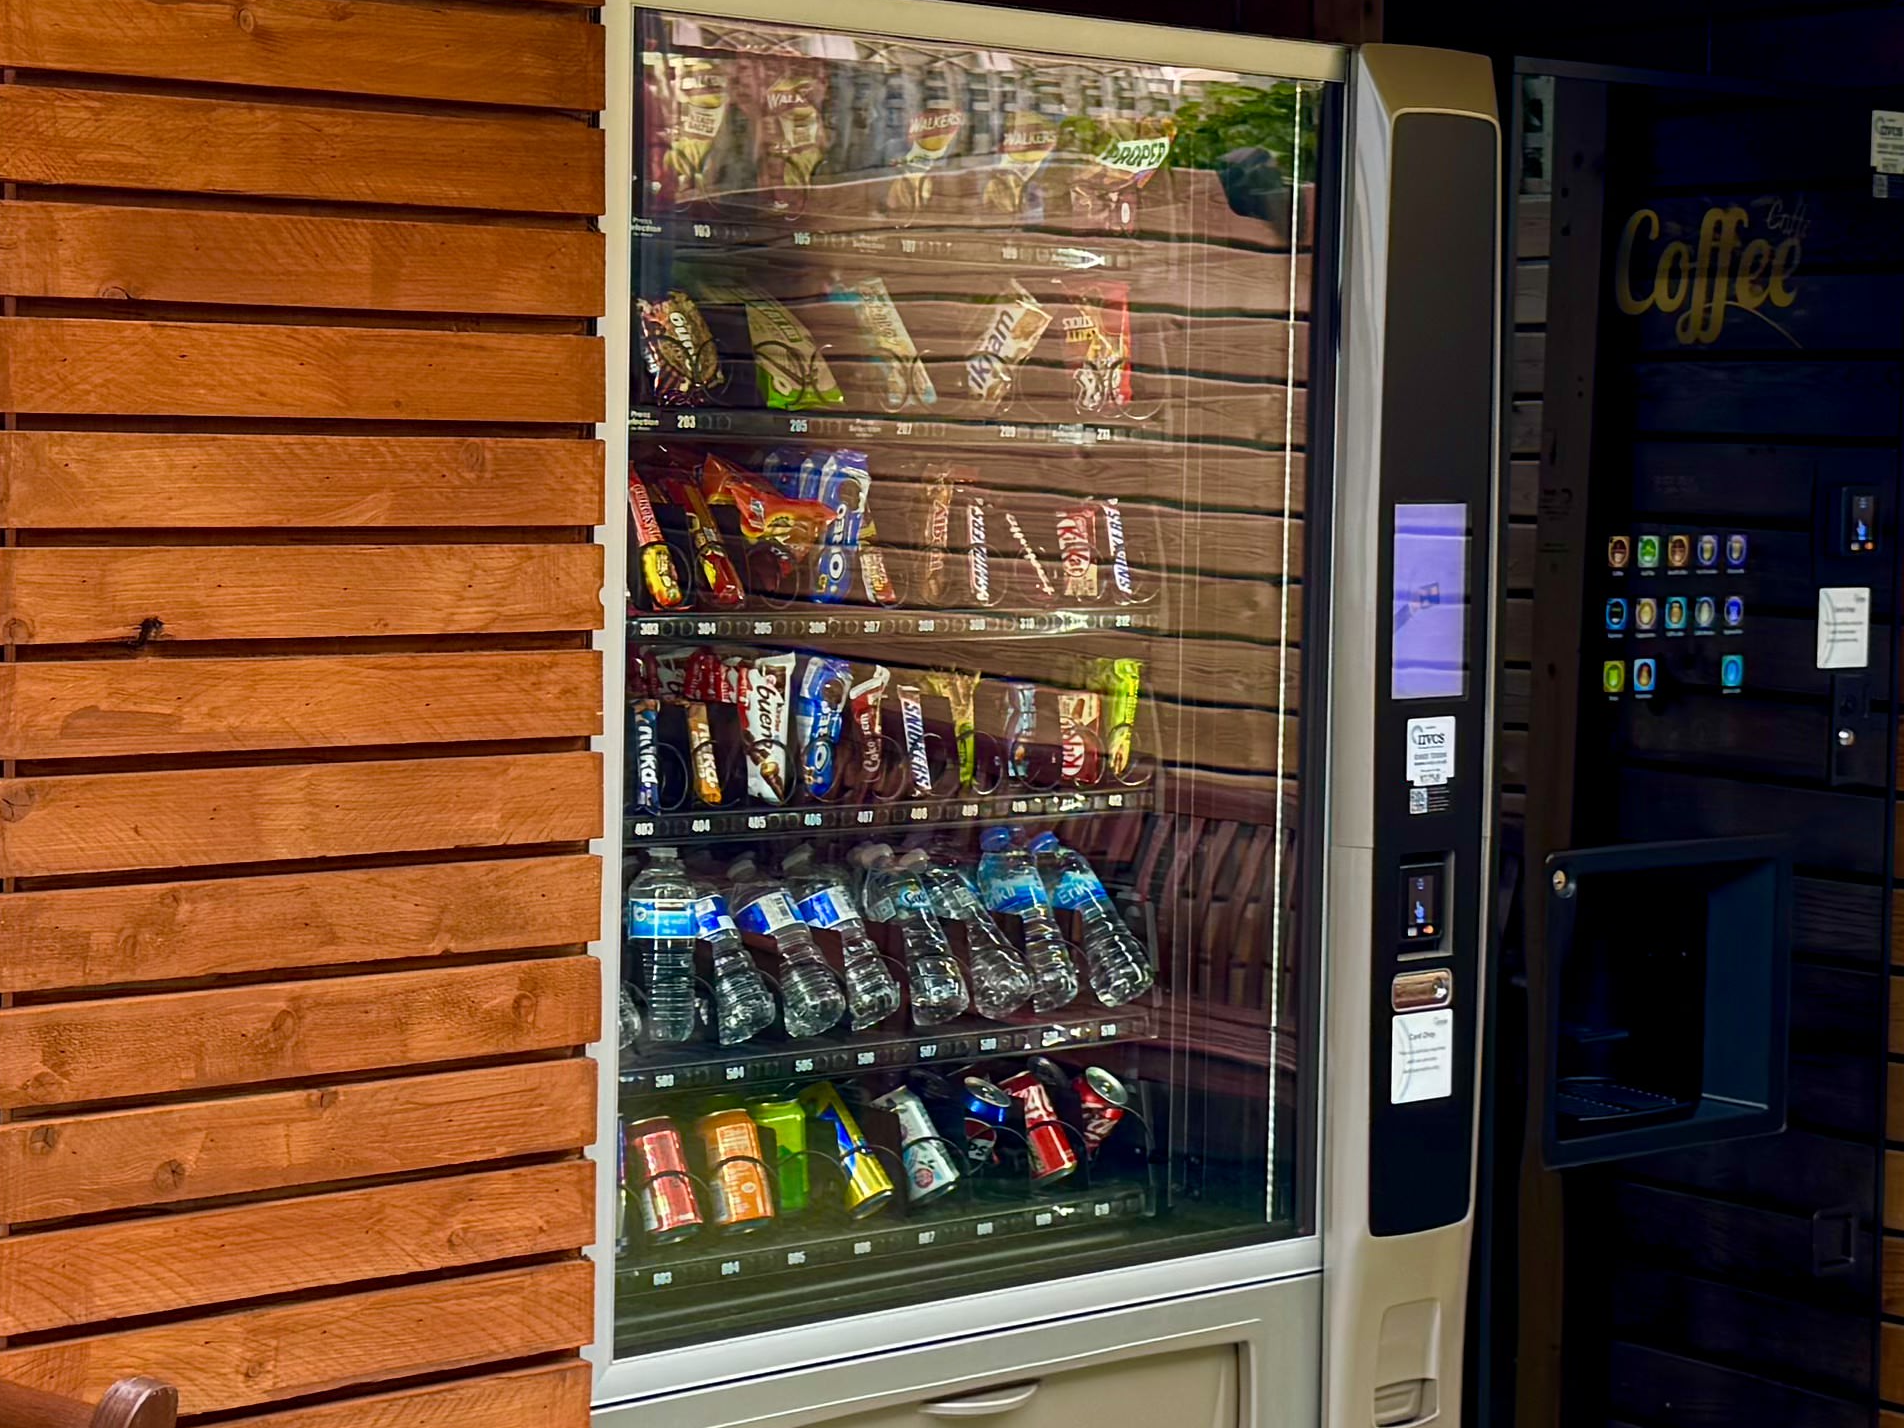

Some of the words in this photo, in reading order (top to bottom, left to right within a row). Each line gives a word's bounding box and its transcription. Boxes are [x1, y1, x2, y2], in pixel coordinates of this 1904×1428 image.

[909, 113, 963, 133] WALKERS
[1003, 129, 1057, 146] WALKERS
[1104, 140, 1167, 168] PROPER
[693, 224, 711, 238] 103
[793, 232, 811, 246] 105
[1615, 207, 1802, 345] Coffee
[677, 415, 696, 429] 203
[790, 419, 808, 433] 205
[896, 422, 913, 436] 207
[1096, 428, 1111, 441] 211
[828, 503, 847, 580] OREO
[697, 622, 717, 636] 304
[863, 620, 881, 634] 307
[756, 684, 777, 750] bueno
[814, 700, 832, 770] OREO
[903, 701, 932, 790] SNICKERS
[748, 816, 767, 829] 405
[804, 813, 822, 826] 406
[857, 810, 874, 823] 407
[634, 822, 654, 836] 403
[692, 819, 711, 832] 404
[919, 1045, 937, 1058] 507
[795, 1058, 814, 1072] 505
[725, 1066, 745, 1080] 504
